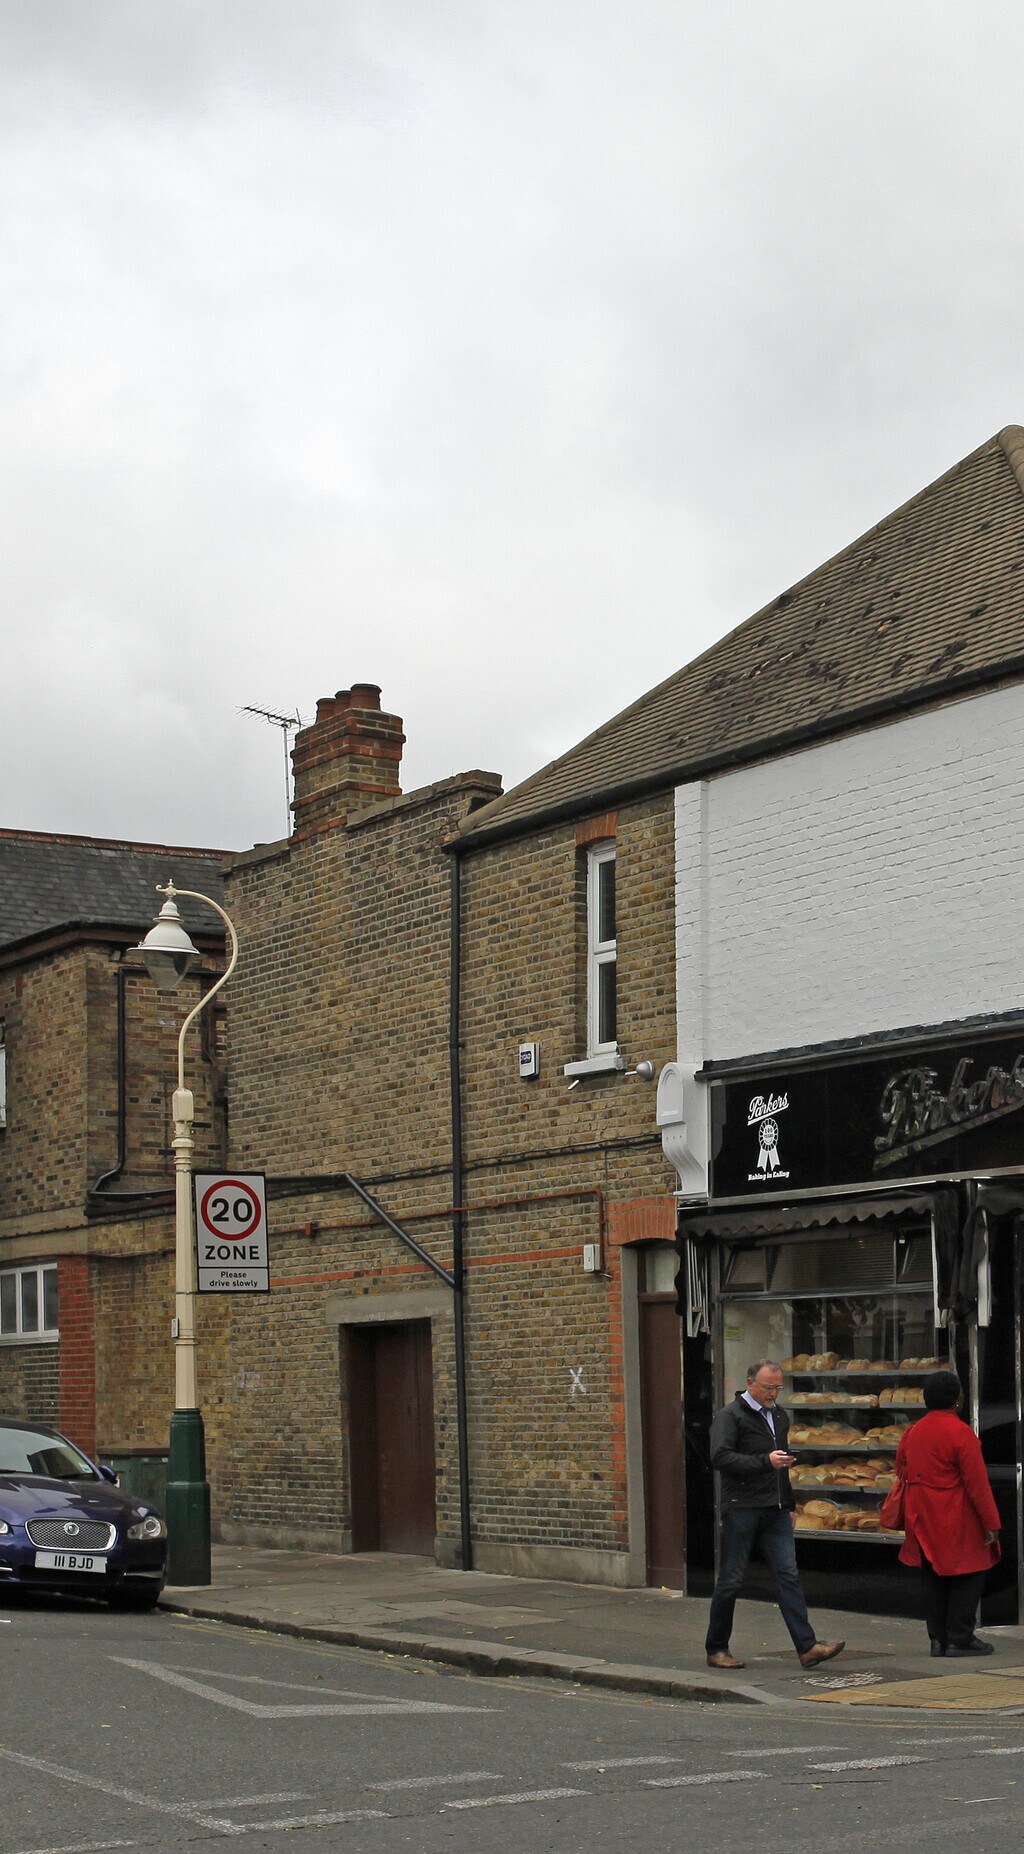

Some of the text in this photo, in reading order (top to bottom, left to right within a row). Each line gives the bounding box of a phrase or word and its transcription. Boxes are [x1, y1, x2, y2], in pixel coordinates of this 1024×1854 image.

[747, 1092, 790, 1121] Parkers
[211, 1198, 253, 1222] 20
[205, 1245, 259, 1260] ZONE
[232, 1280, 258, 1288] slowly
[68, 1556, 94, 1569] BJD
